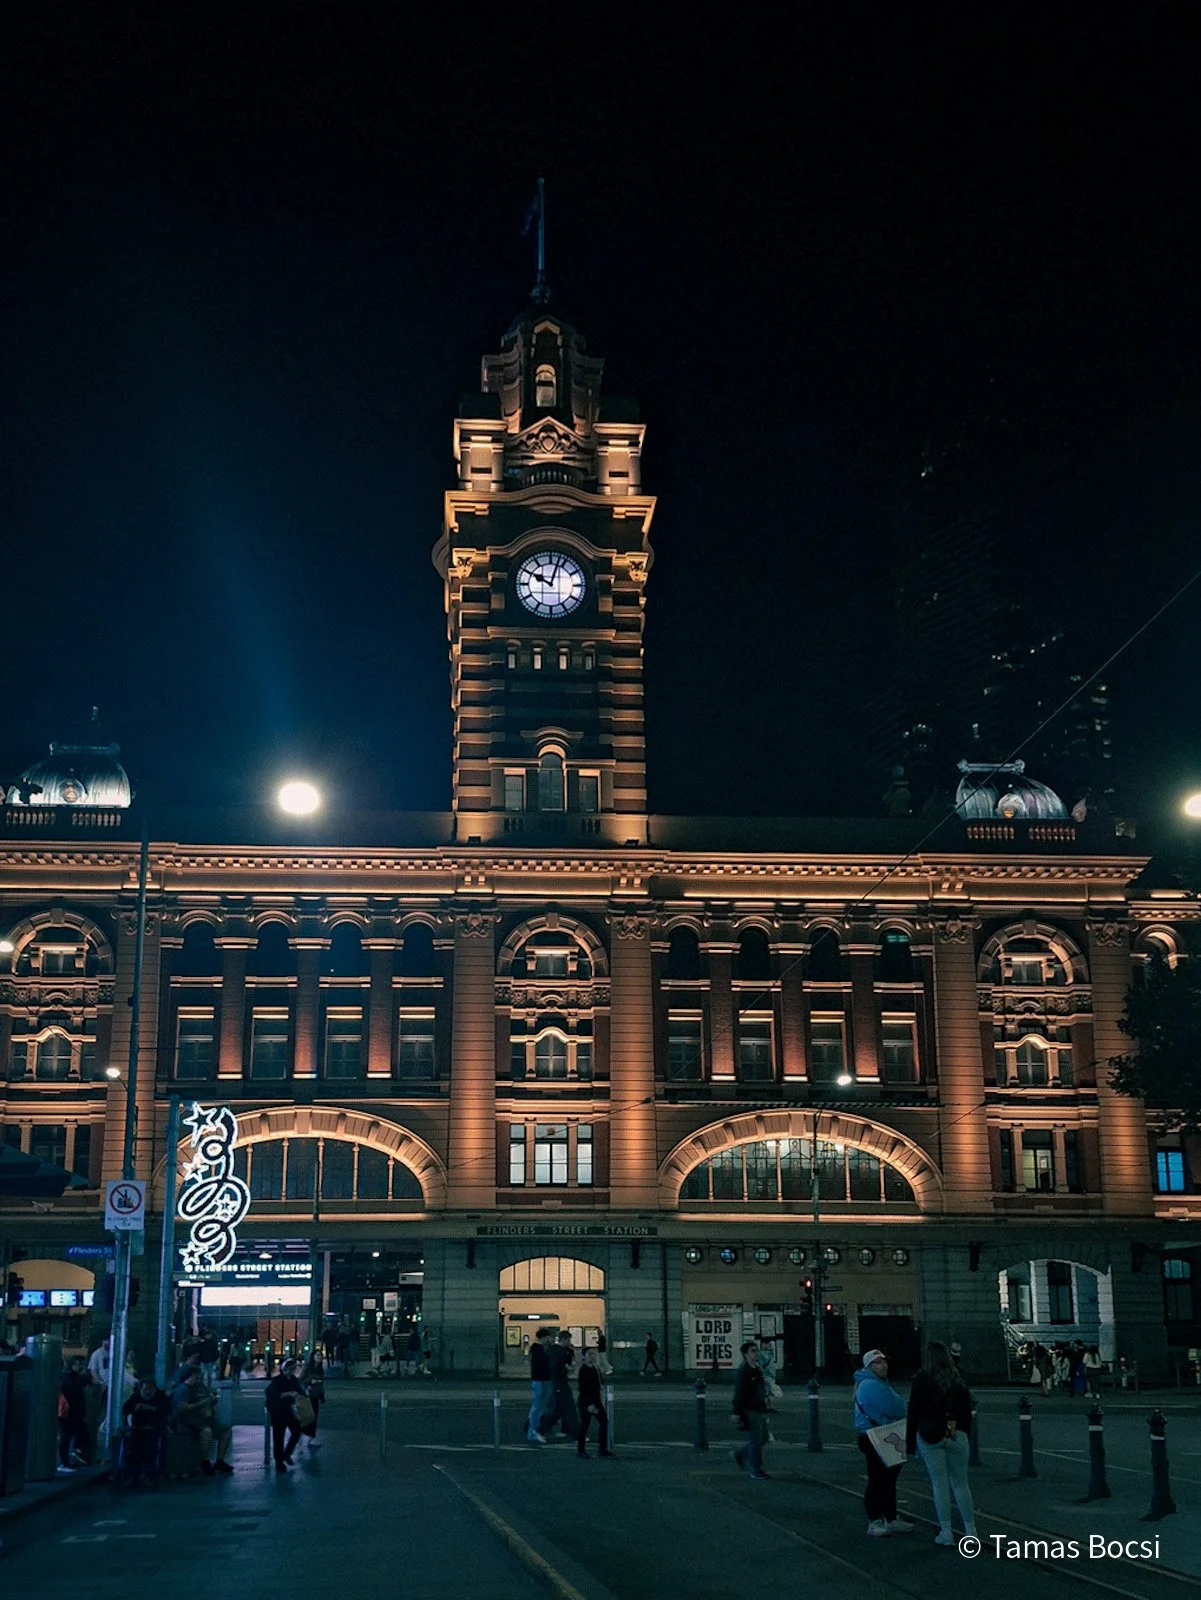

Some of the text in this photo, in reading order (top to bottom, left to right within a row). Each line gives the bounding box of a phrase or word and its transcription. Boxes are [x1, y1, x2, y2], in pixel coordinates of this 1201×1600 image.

[486, 1226, 649, 1235] FLINDERS STREET STATION
[239, 1264, 273, 1272] STREET
[274, 1264, 313, 1272] STATION
[695, 1320, 732, 1334] LORD
[701, 1335, 726, 1343] OF THE
[695, 1344, 733, 1360] FRIES
